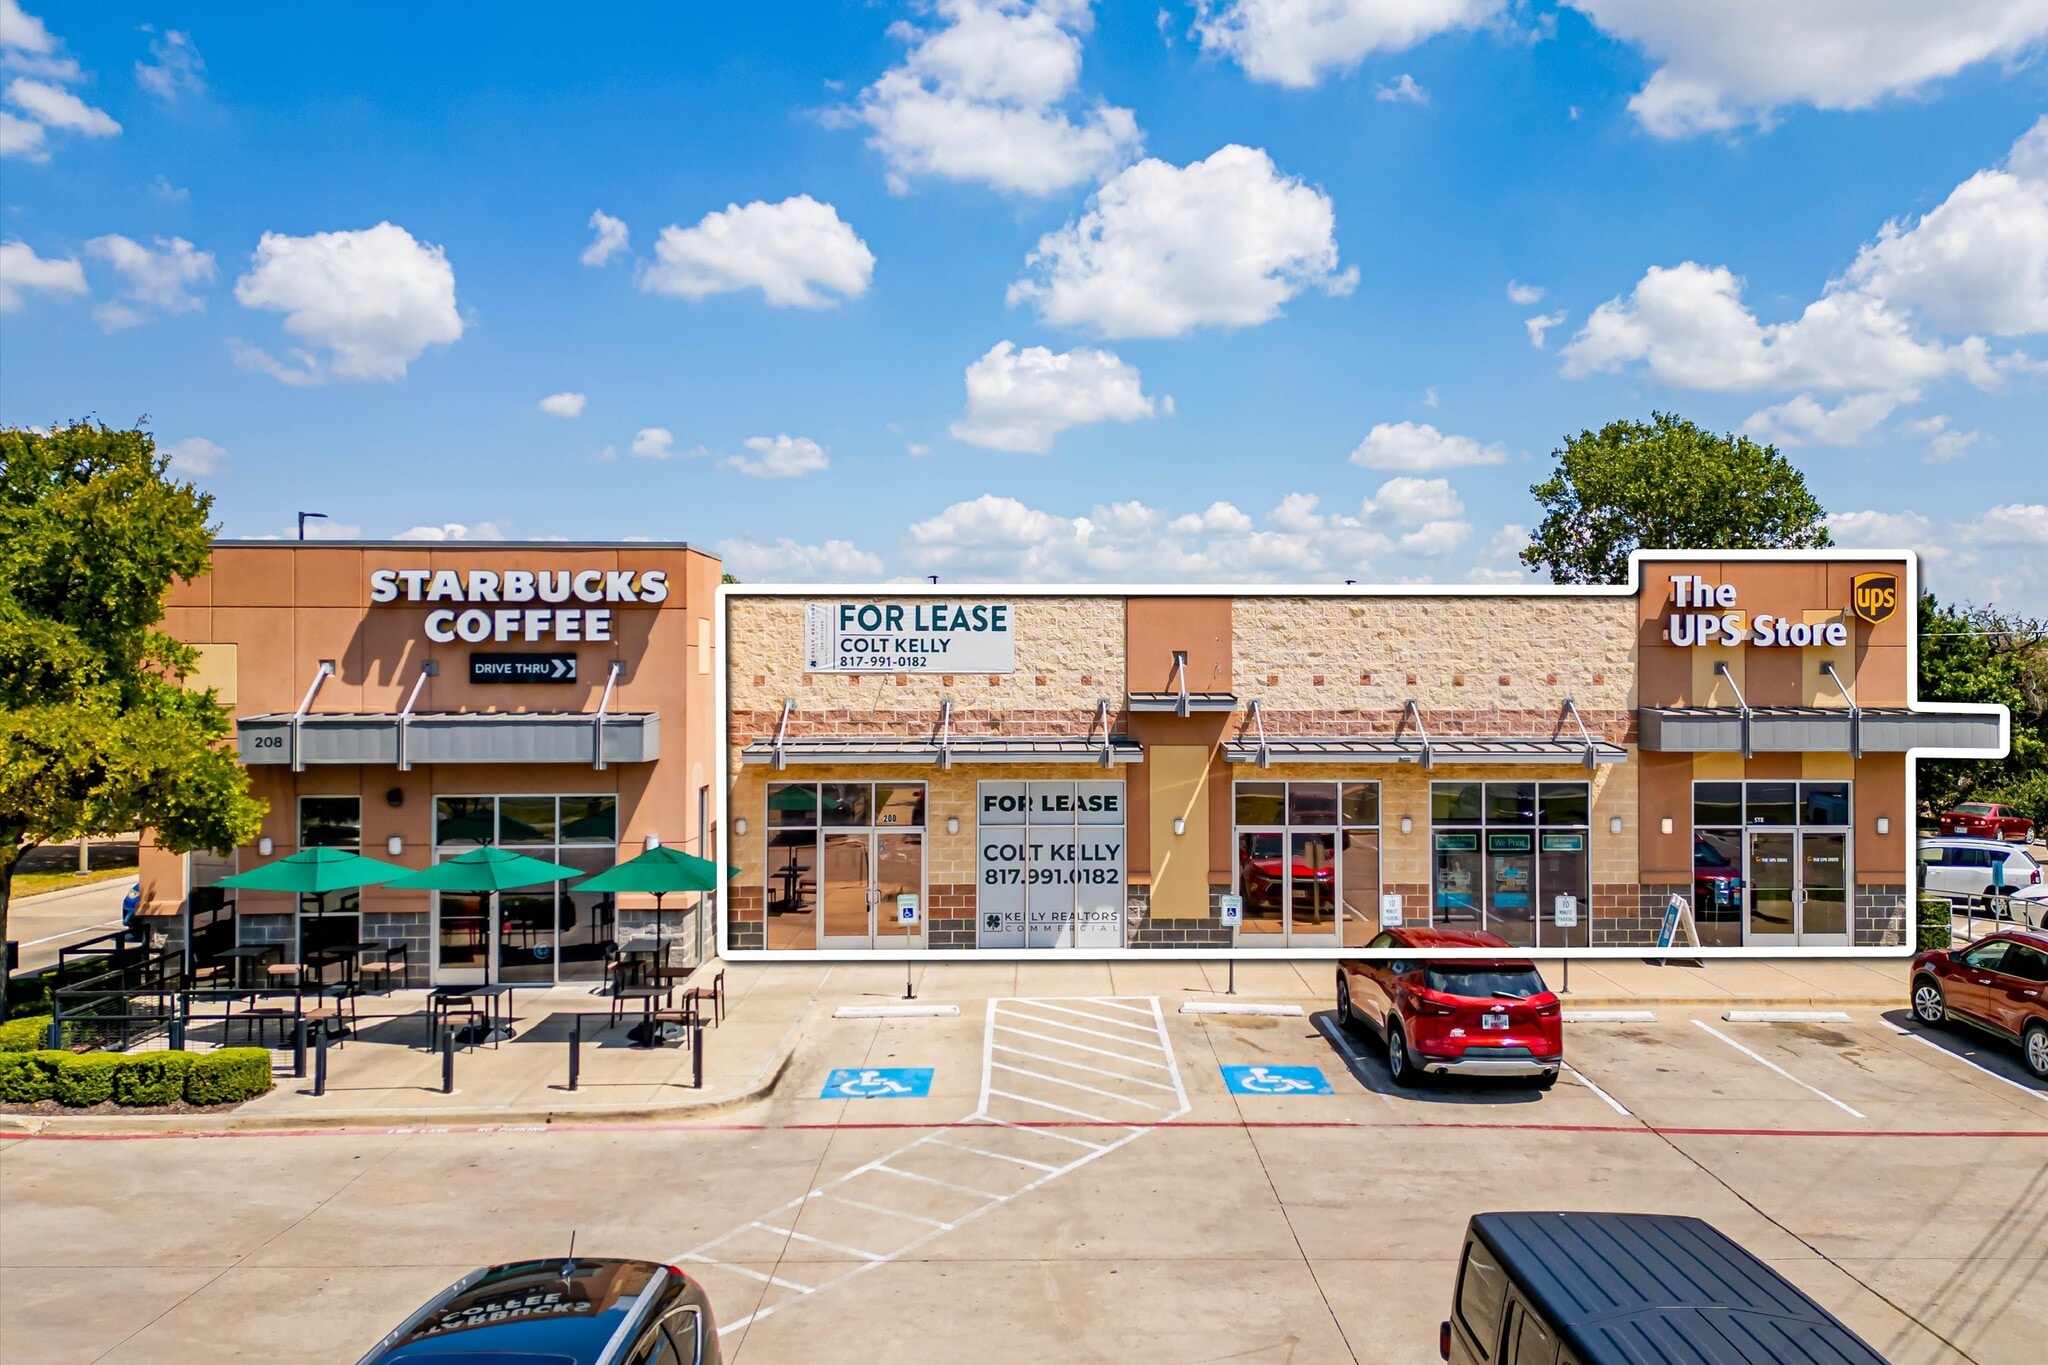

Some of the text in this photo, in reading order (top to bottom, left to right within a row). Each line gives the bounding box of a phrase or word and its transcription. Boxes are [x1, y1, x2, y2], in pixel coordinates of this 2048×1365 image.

[370, 569, 668, 603] STARBUCKS
[1669, 575, 1738, 608] The
[1857, 587, 1895, 616] ups
[424, 608, 611, 643] COFFEE
[840, 604, 904, 632] FOR
[915, 604, 1007, 632] LEASE
[1668, 614, 1848, 647] UPS Store
[840, 638, 951, 653] COLT KELLY
[475, 664, 549, 674] DRIVE THRU
[840, 656, 927, 667] 817-991-0182
[254, 736, 282, 748] 208
[984, 795, 1118, 812] FOR LEASE
[883, 814, 897, 823] 200
[983, 844, 1120, 861] COLT KELLY
[985, 868, 1119, 885] 817.991.0182
[1389, 899, 1396, 908] 10
[1562, 900, 1570, 909] 10
[1005, 912, 1118, 921] KELLY REALTORS
